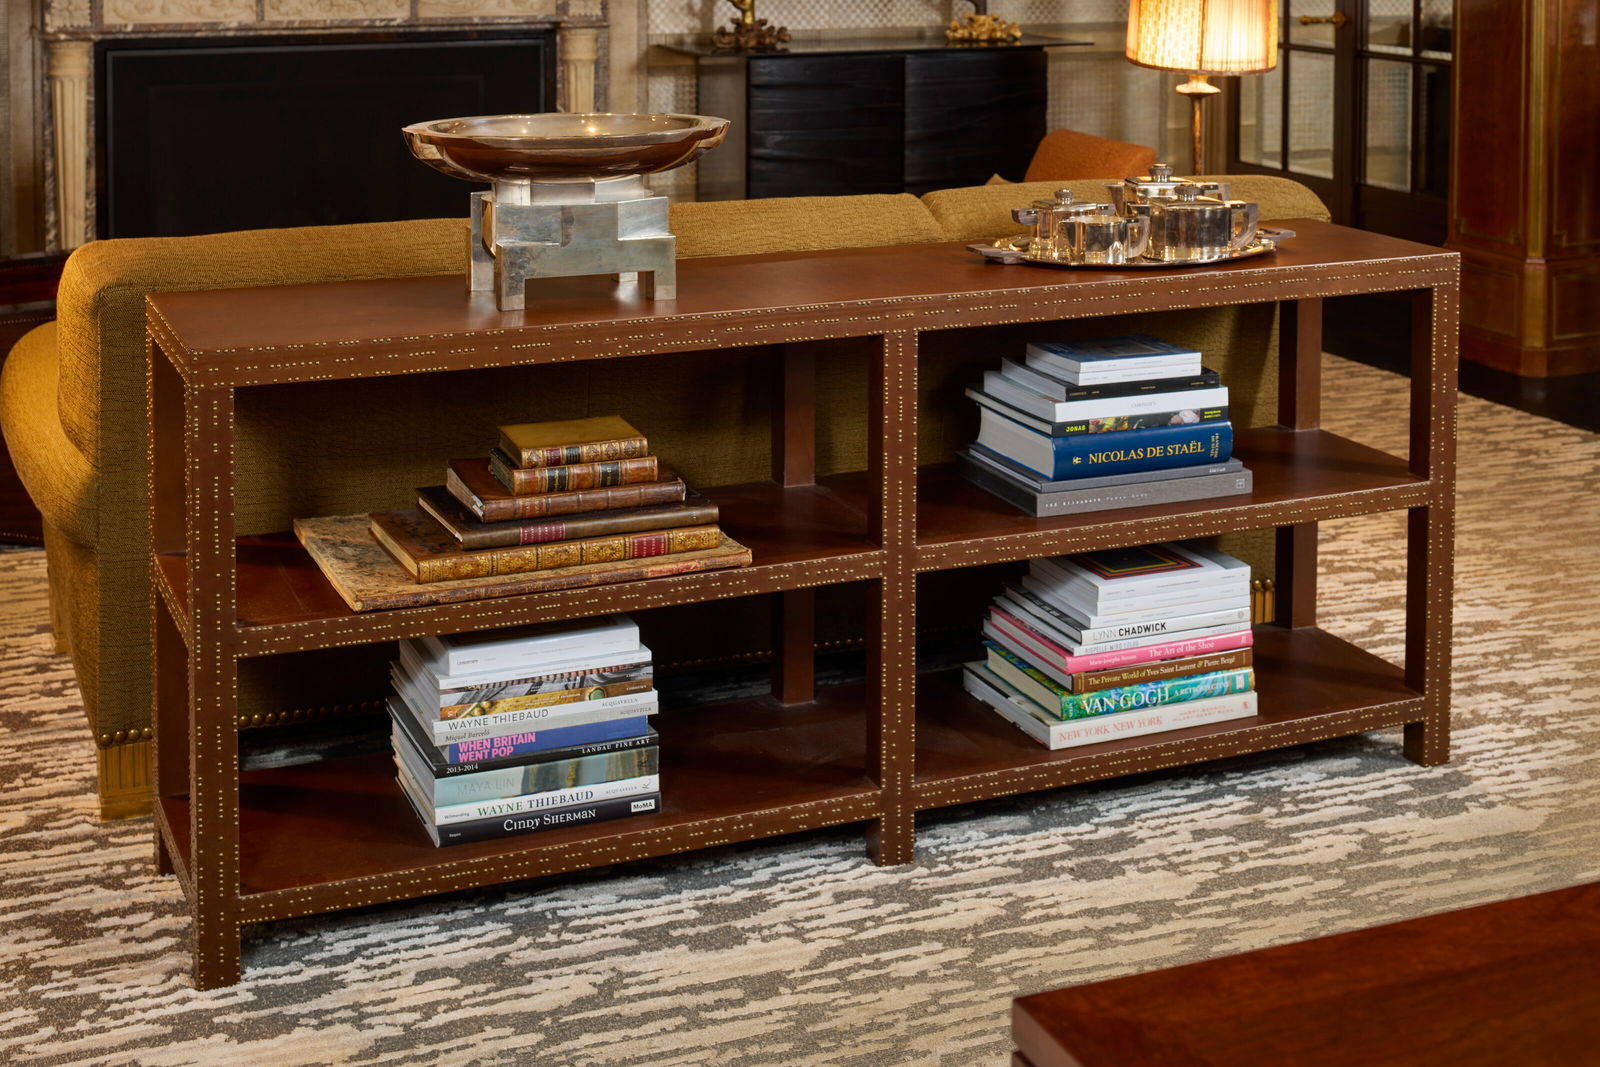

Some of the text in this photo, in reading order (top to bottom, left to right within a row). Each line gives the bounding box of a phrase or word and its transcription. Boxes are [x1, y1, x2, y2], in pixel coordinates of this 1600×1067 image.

[1088, 448, 1144, 464] NICOLAS
[1146, 446, 1165, 458] DE
[1166, 440, 1205, 456] STAËL
[1093, 622, 1167, 641] LYNN CHADWICK
[1148, 648, 1163, 657] The
[1163, 647, 1176, 655] Art
[1185, 644, 1197, 652] the
[1198, 641, 1215, 650] Shoe
[1088, 677, 1101, 686] The
[1101, 674, 1121, 684] Private
[1121, 671, 1140, 681] World
[1139, 669, 1147, 678] of
[1146, 668, 1160, 677] Yves
[1160, 665, 1175, 673] Saint
[1175, 663, 1197, 672] Laurent
[1203, 659, 1220, 668] Pierre
[1220, 656, 1236, 665] Bergé
[601, 698, 638, 708] ACQUAVELLA
[1082, 697, 1117, 714] VAN
[1120, 687, 1169, 709] GOGH
[620, 706, 652, 715] ACQUAVELLA
[448, 708, 549, 731] WAYNE THIEBAUD
[1060, 715, 1164, 741] NEW YORK NEW YORK
[445, 729, 490, 743] Miquel Barceló
[458, 732, 536, 753] WHEN BRITAIN
[458, 746, 514, 763] WENT POP
[581, 738, 650, 754] LANDAU FINE ART
[446, 763, 479, 774] 2013-2014
[457, 778, 515, 795] MAYA LIN
[606, 786, 638, 795] ACQUAVELLA
[477, 790, 594, 817] WAYNE THIEBAUD
[632, 801, 653, 810] MoMA
[503, 817, 540, 831] Cindy
